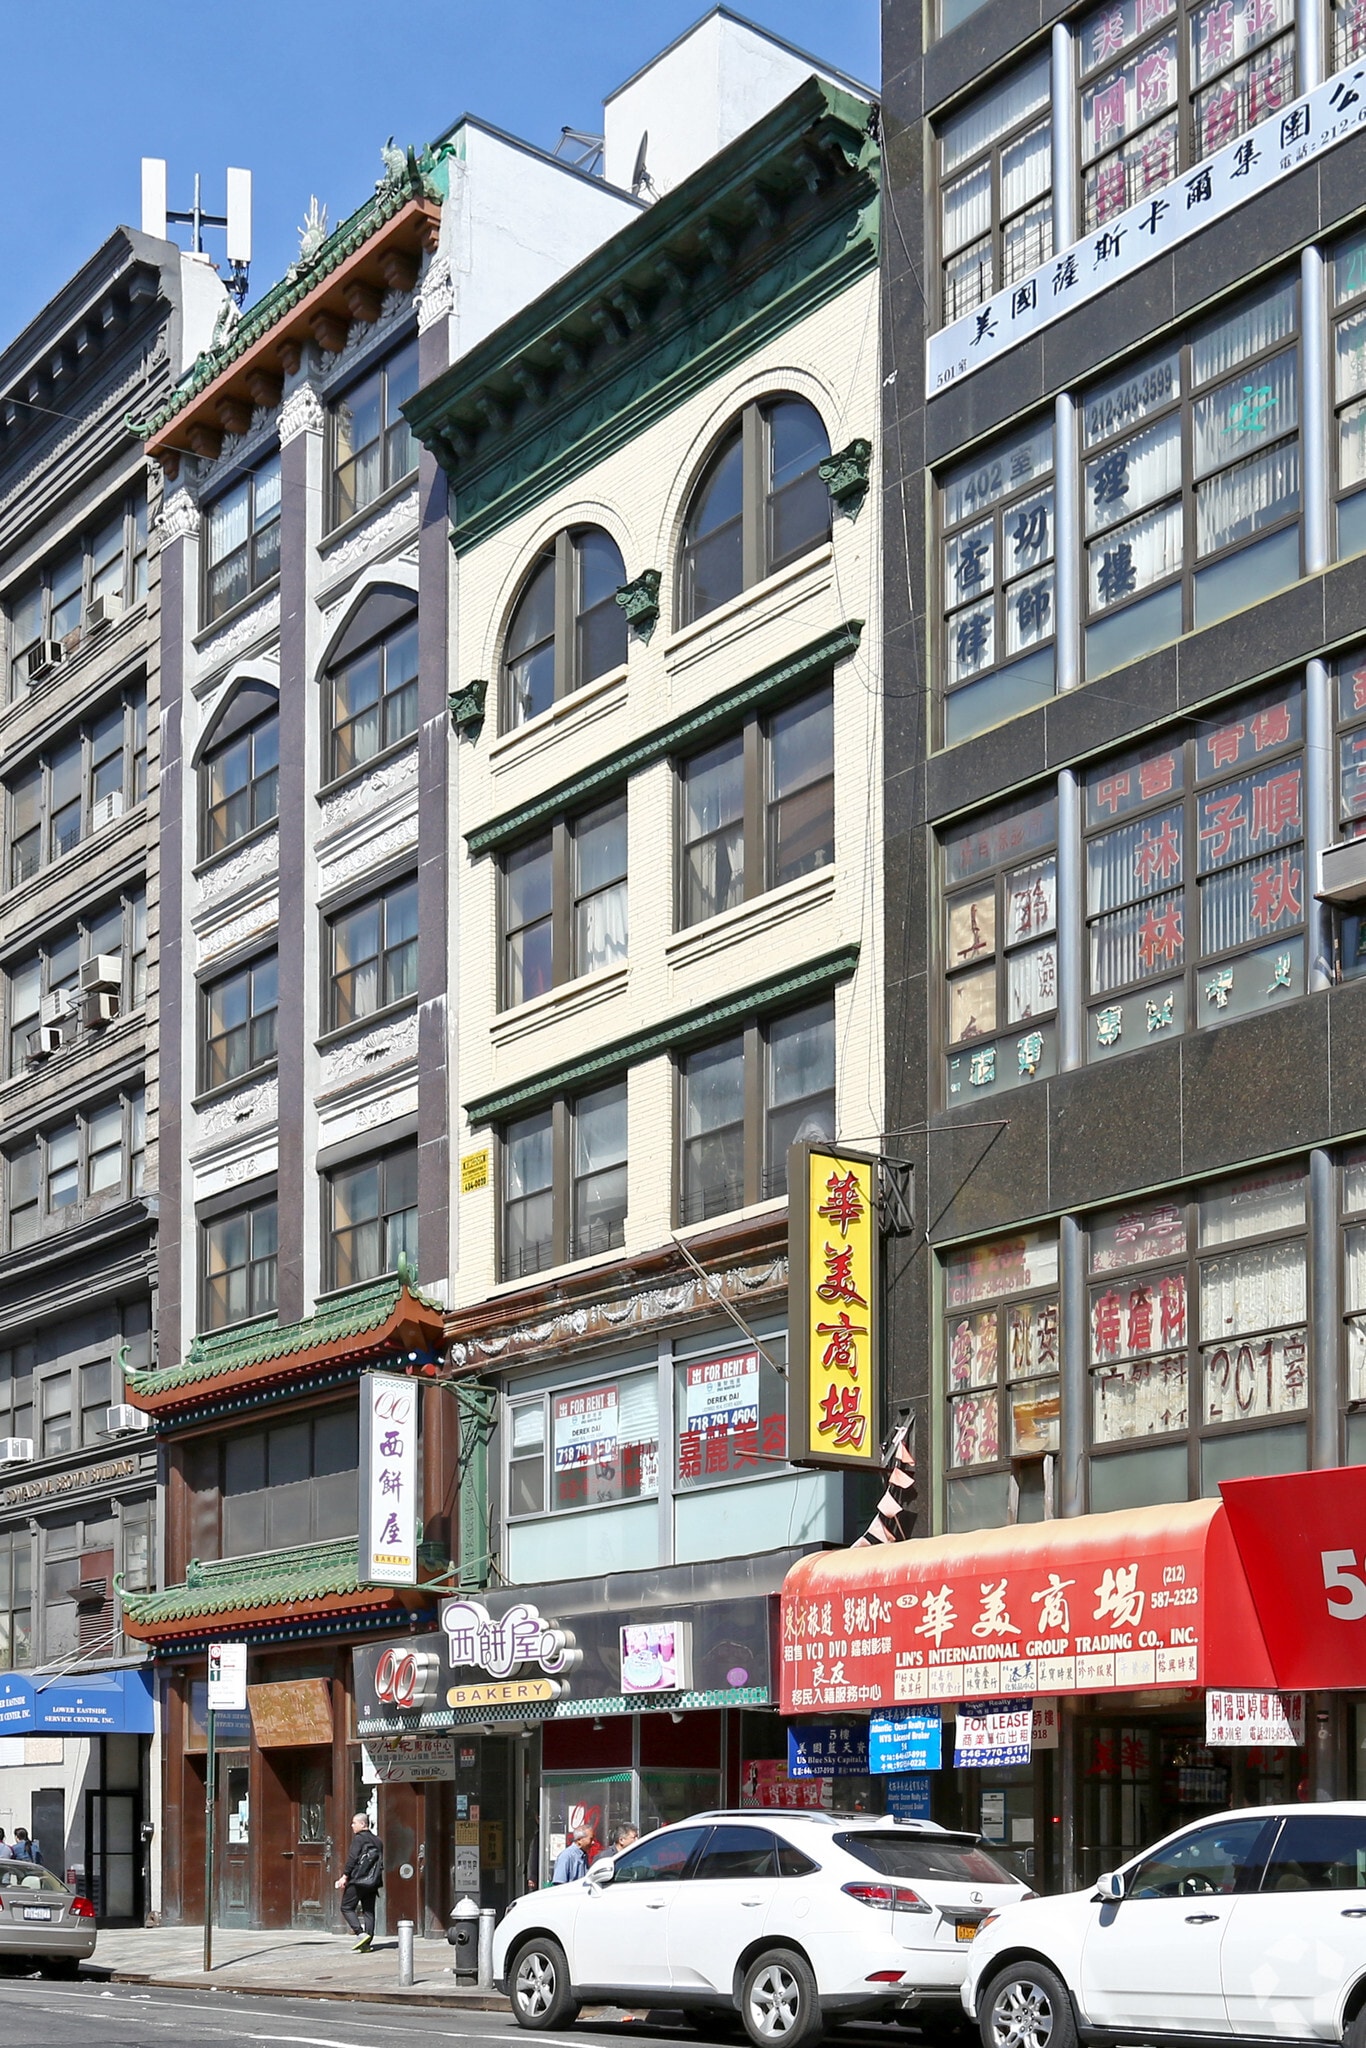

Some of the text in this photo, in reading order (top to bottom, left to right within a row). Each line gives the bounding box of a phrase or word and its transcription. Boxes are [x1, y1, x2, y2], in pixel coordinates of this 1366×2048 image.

[817, 1170, 868, 1449] 華美商場
[704, 1364, 720, 1382] FOR
[722, 1359, 744, 1379] RENT
[374, 1389, 412, 1425] QQ
[570, 1398, 584, 1415] FOR
[586, 1393, 605, 1412] RENT
[707, 1394, 728, 1405] DEREK
[56, 1471, 89, 1492] BROWN
[90, 1460, 135, 1484] BUILDING
[378, 1431, 405, 1546] 西餅屋
[374, 1555, 410, 1565] BAKERY
[1163, 1564, 1186, 1587] (212)
[901, 1595, 913, 1606] 52
[915, 1563, 1145, 1648] 華美商場
[1151, 1587, 1198, 1609] 587-2323
[843, 1593, 892, 1635] 影視中心
[446, 1611, 556, 1671] 西餅屋
[806, 1642, 825, 1660] VCD
[829, 1639, 848, 1659] DVD
[896, 1651, 924, 1668] LIN'S
[928, 1641, 1020, 1665] INTERNATIONAL
[1026, 1638, 1069, 1657] GROUP
[1075, 1632, 1133, 1653] TRADING
[1170, 1626, 1199, 1645] INC.
[374, 1647, 417, 1709] QQ
[812, 1660, 851, 1687] 良友
[455, 1685, 544, 1703] BAKERY
[791, 1684, 882, 1706] 移民入籍服務中心
[44, 1715, 73, 1723] SERVICE
[52, 1706, 107, 1715] LOWER EASTSIDE
[963, 1712, 1029, 1732] FOR LEASE
[796, 1754, 807, 1764] US
[807, 1754, 823, 1764] Blue
[823, 1753, 836, 1765] Sky
[960, 1745, 1029, 1758] 646-770-6111
[960, 1755, 1028, 1767] 212-349-5334
